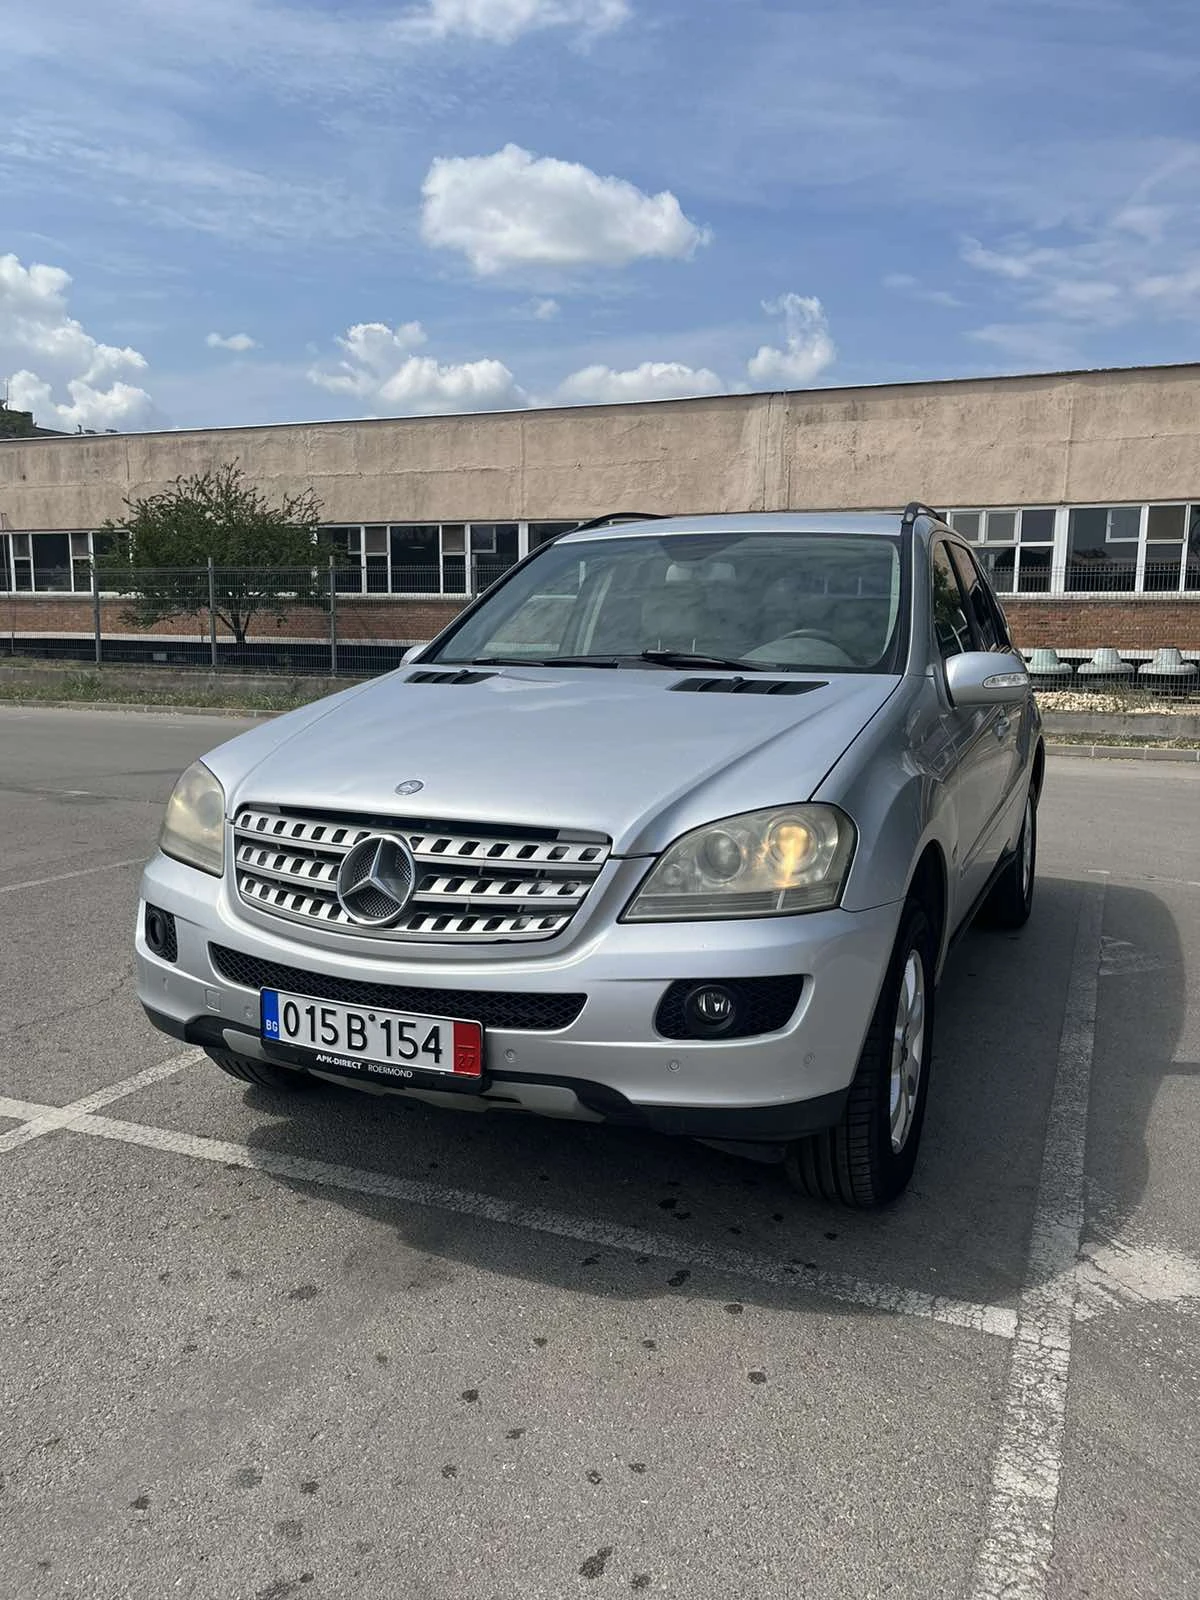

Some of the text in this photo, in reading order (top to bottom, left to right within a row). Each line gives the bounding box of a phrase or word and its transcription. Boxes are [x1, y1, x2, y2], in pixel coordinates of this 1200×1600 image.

[265, 1019, 278, 1032] BG
[316, 1054, 413, 1078] APK-DIRECT ROERMOND
